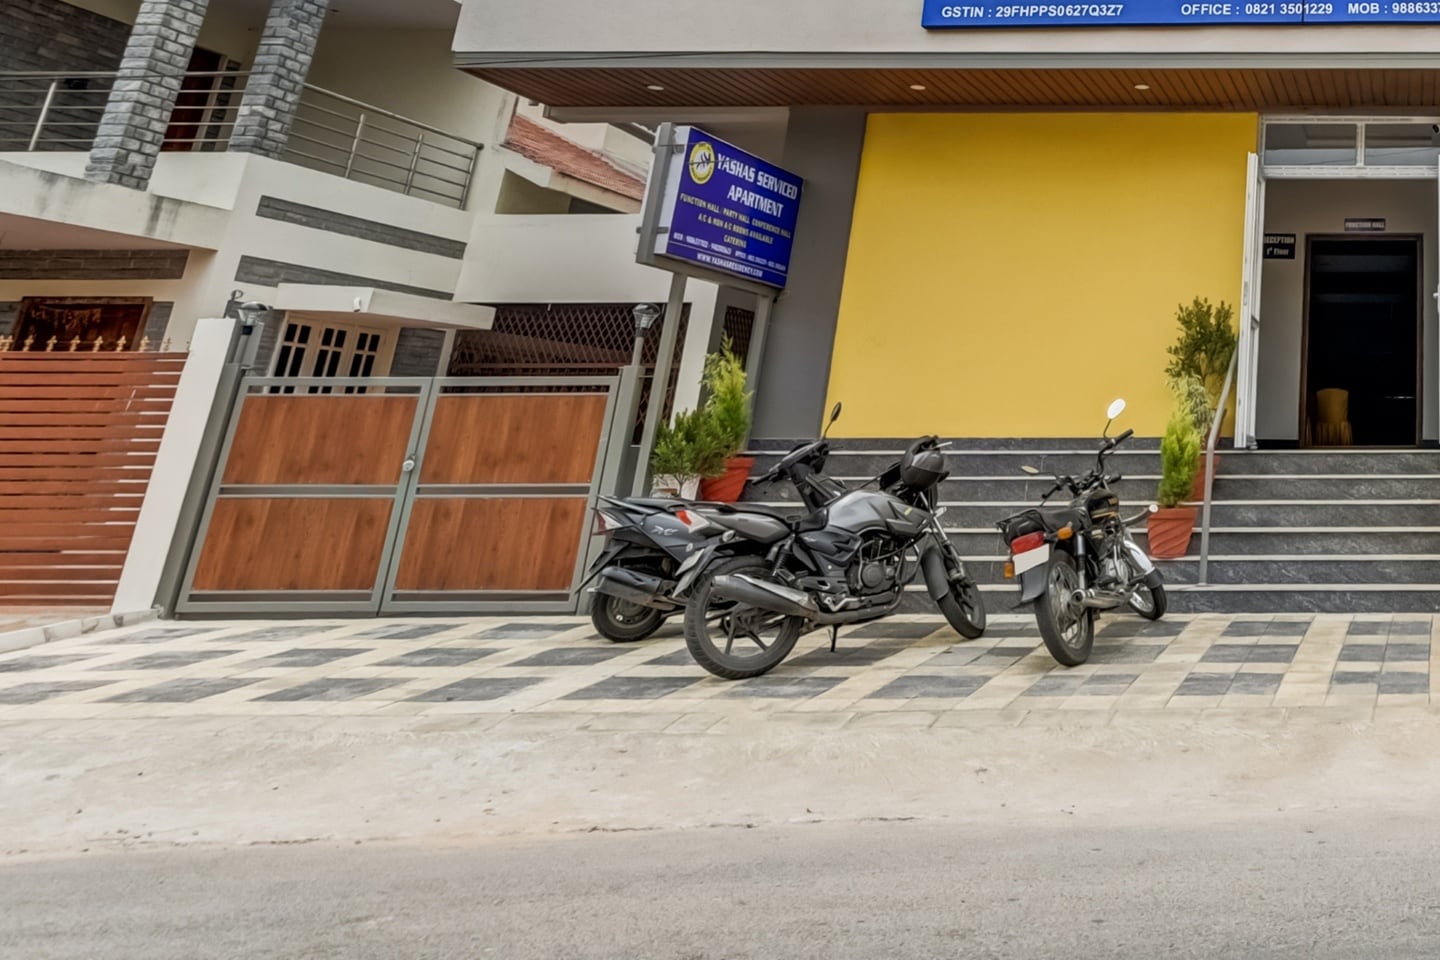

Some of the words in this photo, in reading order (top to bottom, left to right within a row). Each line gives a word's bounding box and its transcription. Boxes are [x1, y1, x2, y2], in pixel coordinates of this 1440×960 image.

[941, 6, 984, 18] GSTIN
[995, 4, 1124, 18] 29FHPPS0627Q3Z7
[1180, 3, 1232, 16] OFFICE
[1244, 3, 1276, 15] 0821
[1279, 3, 1333, 15] 3501229
[1348, 2, 1381, 15] MOB
[717, 153, 756, 182] YASHAS
[756, 170, 798, 200] SERVICED
[727, 184, 784, 218] APARTMENT
